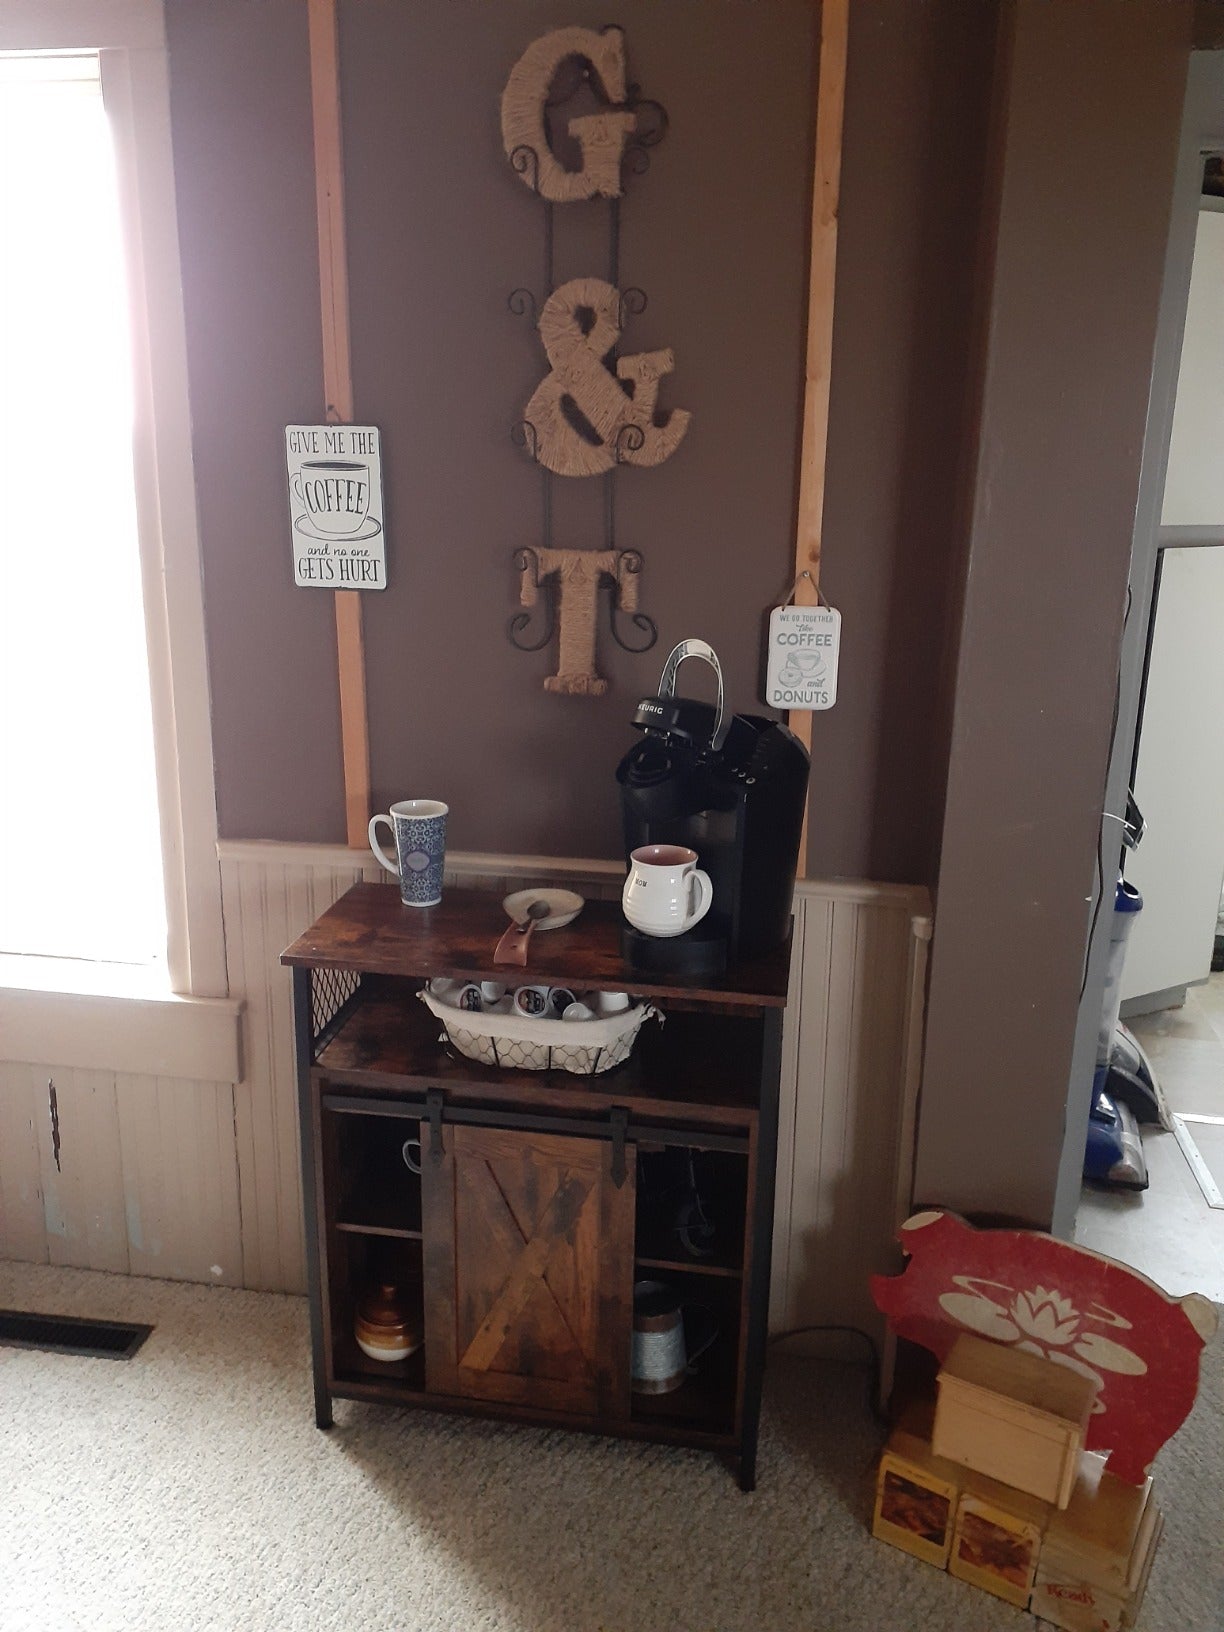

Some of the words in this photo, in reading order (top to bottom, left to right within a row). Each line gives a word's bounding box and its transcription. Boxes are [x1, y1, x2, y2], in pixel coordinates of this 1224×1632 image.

[500, 25, 637, 201] G
[521, 276, 692, 477] &
[289, 431, 320, 454] GIVE
[325, 431, 346, 454] ME
[350, 432, 375, 455] THE
[305, 479, 367, 515] COFFEE
[307, 543, 330, 557] and
[333, 548, 347, 557] no
[350, 548, 370, 557] one
[298, 557, 334, 580] GETS
[339, 558, 381, 582] HURT
[520, 546, 639, 696] T
[779, 614, 789, 622] WE
[791, 614, 800, 622] GO
[802, 615, 834, 623] TOGETHER
[776, 633, 833, 646] COFFEE
[806, 678, 826, 688] and
[773, 690, 829, 704] DONUTS
[637, 703, 664, 715] KEURIG
